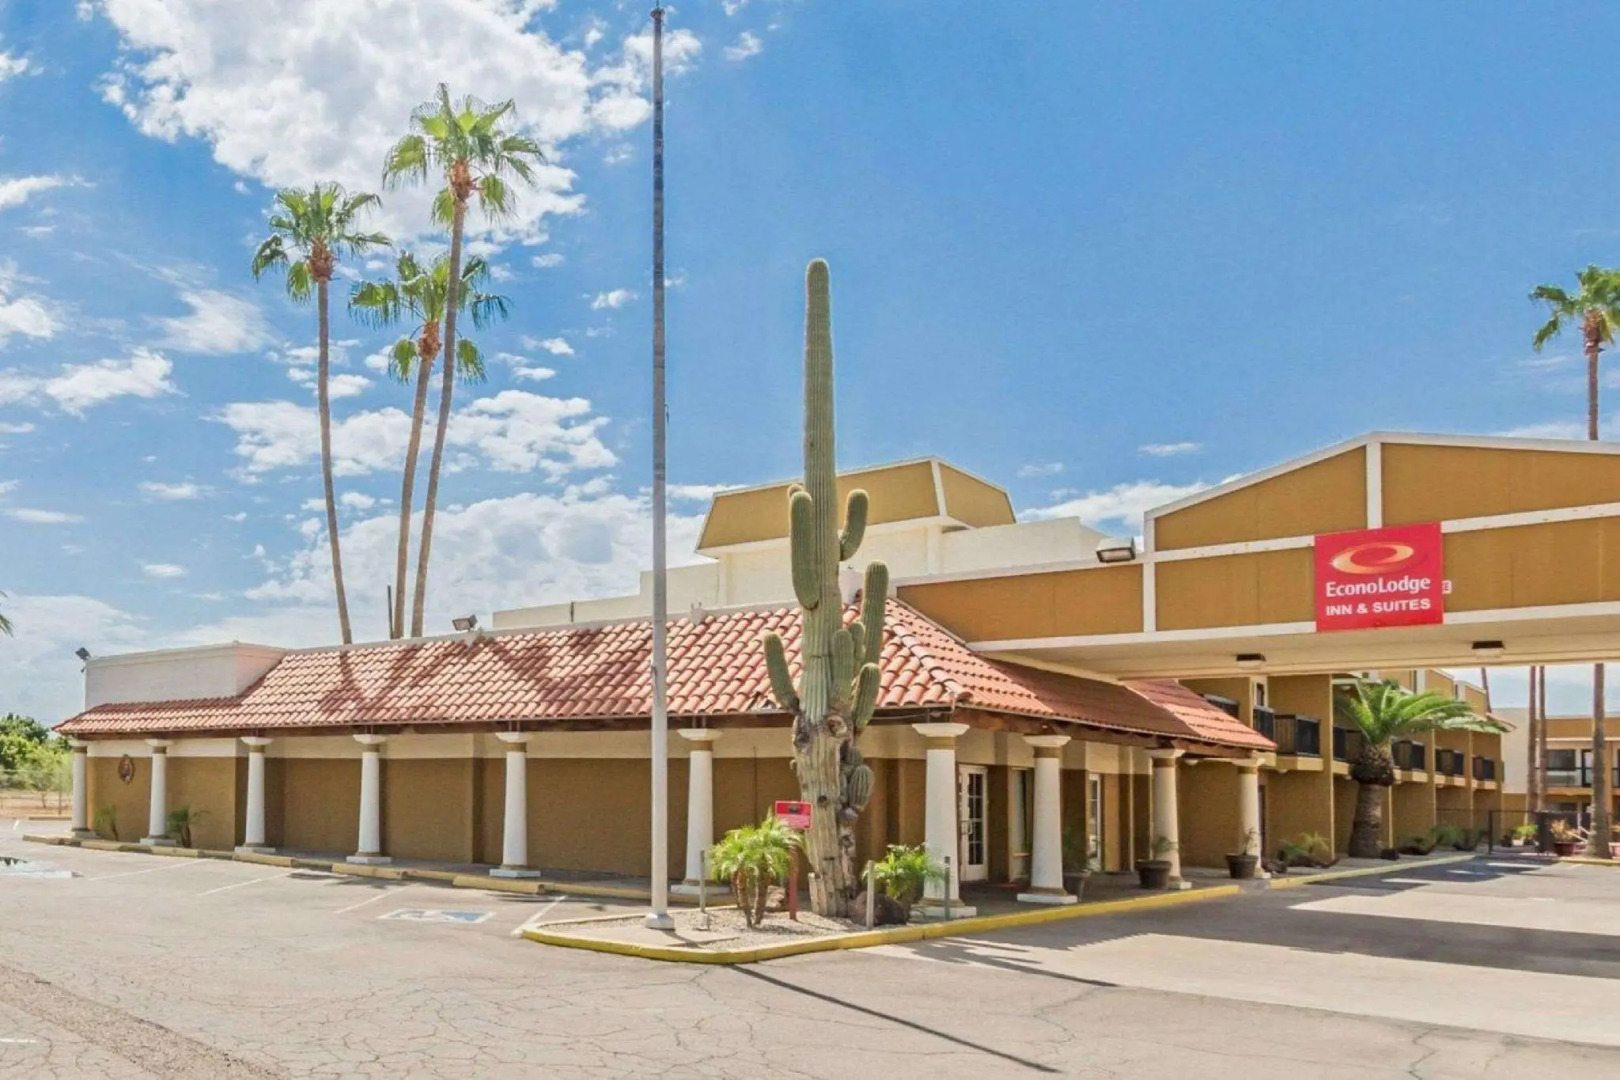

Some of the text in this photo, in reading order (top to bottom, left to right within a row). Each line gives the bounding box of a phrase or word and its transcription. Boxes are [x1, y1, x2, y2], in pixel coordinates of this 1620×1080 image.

[1325, 598, 1431, 616] INN & SUITES
